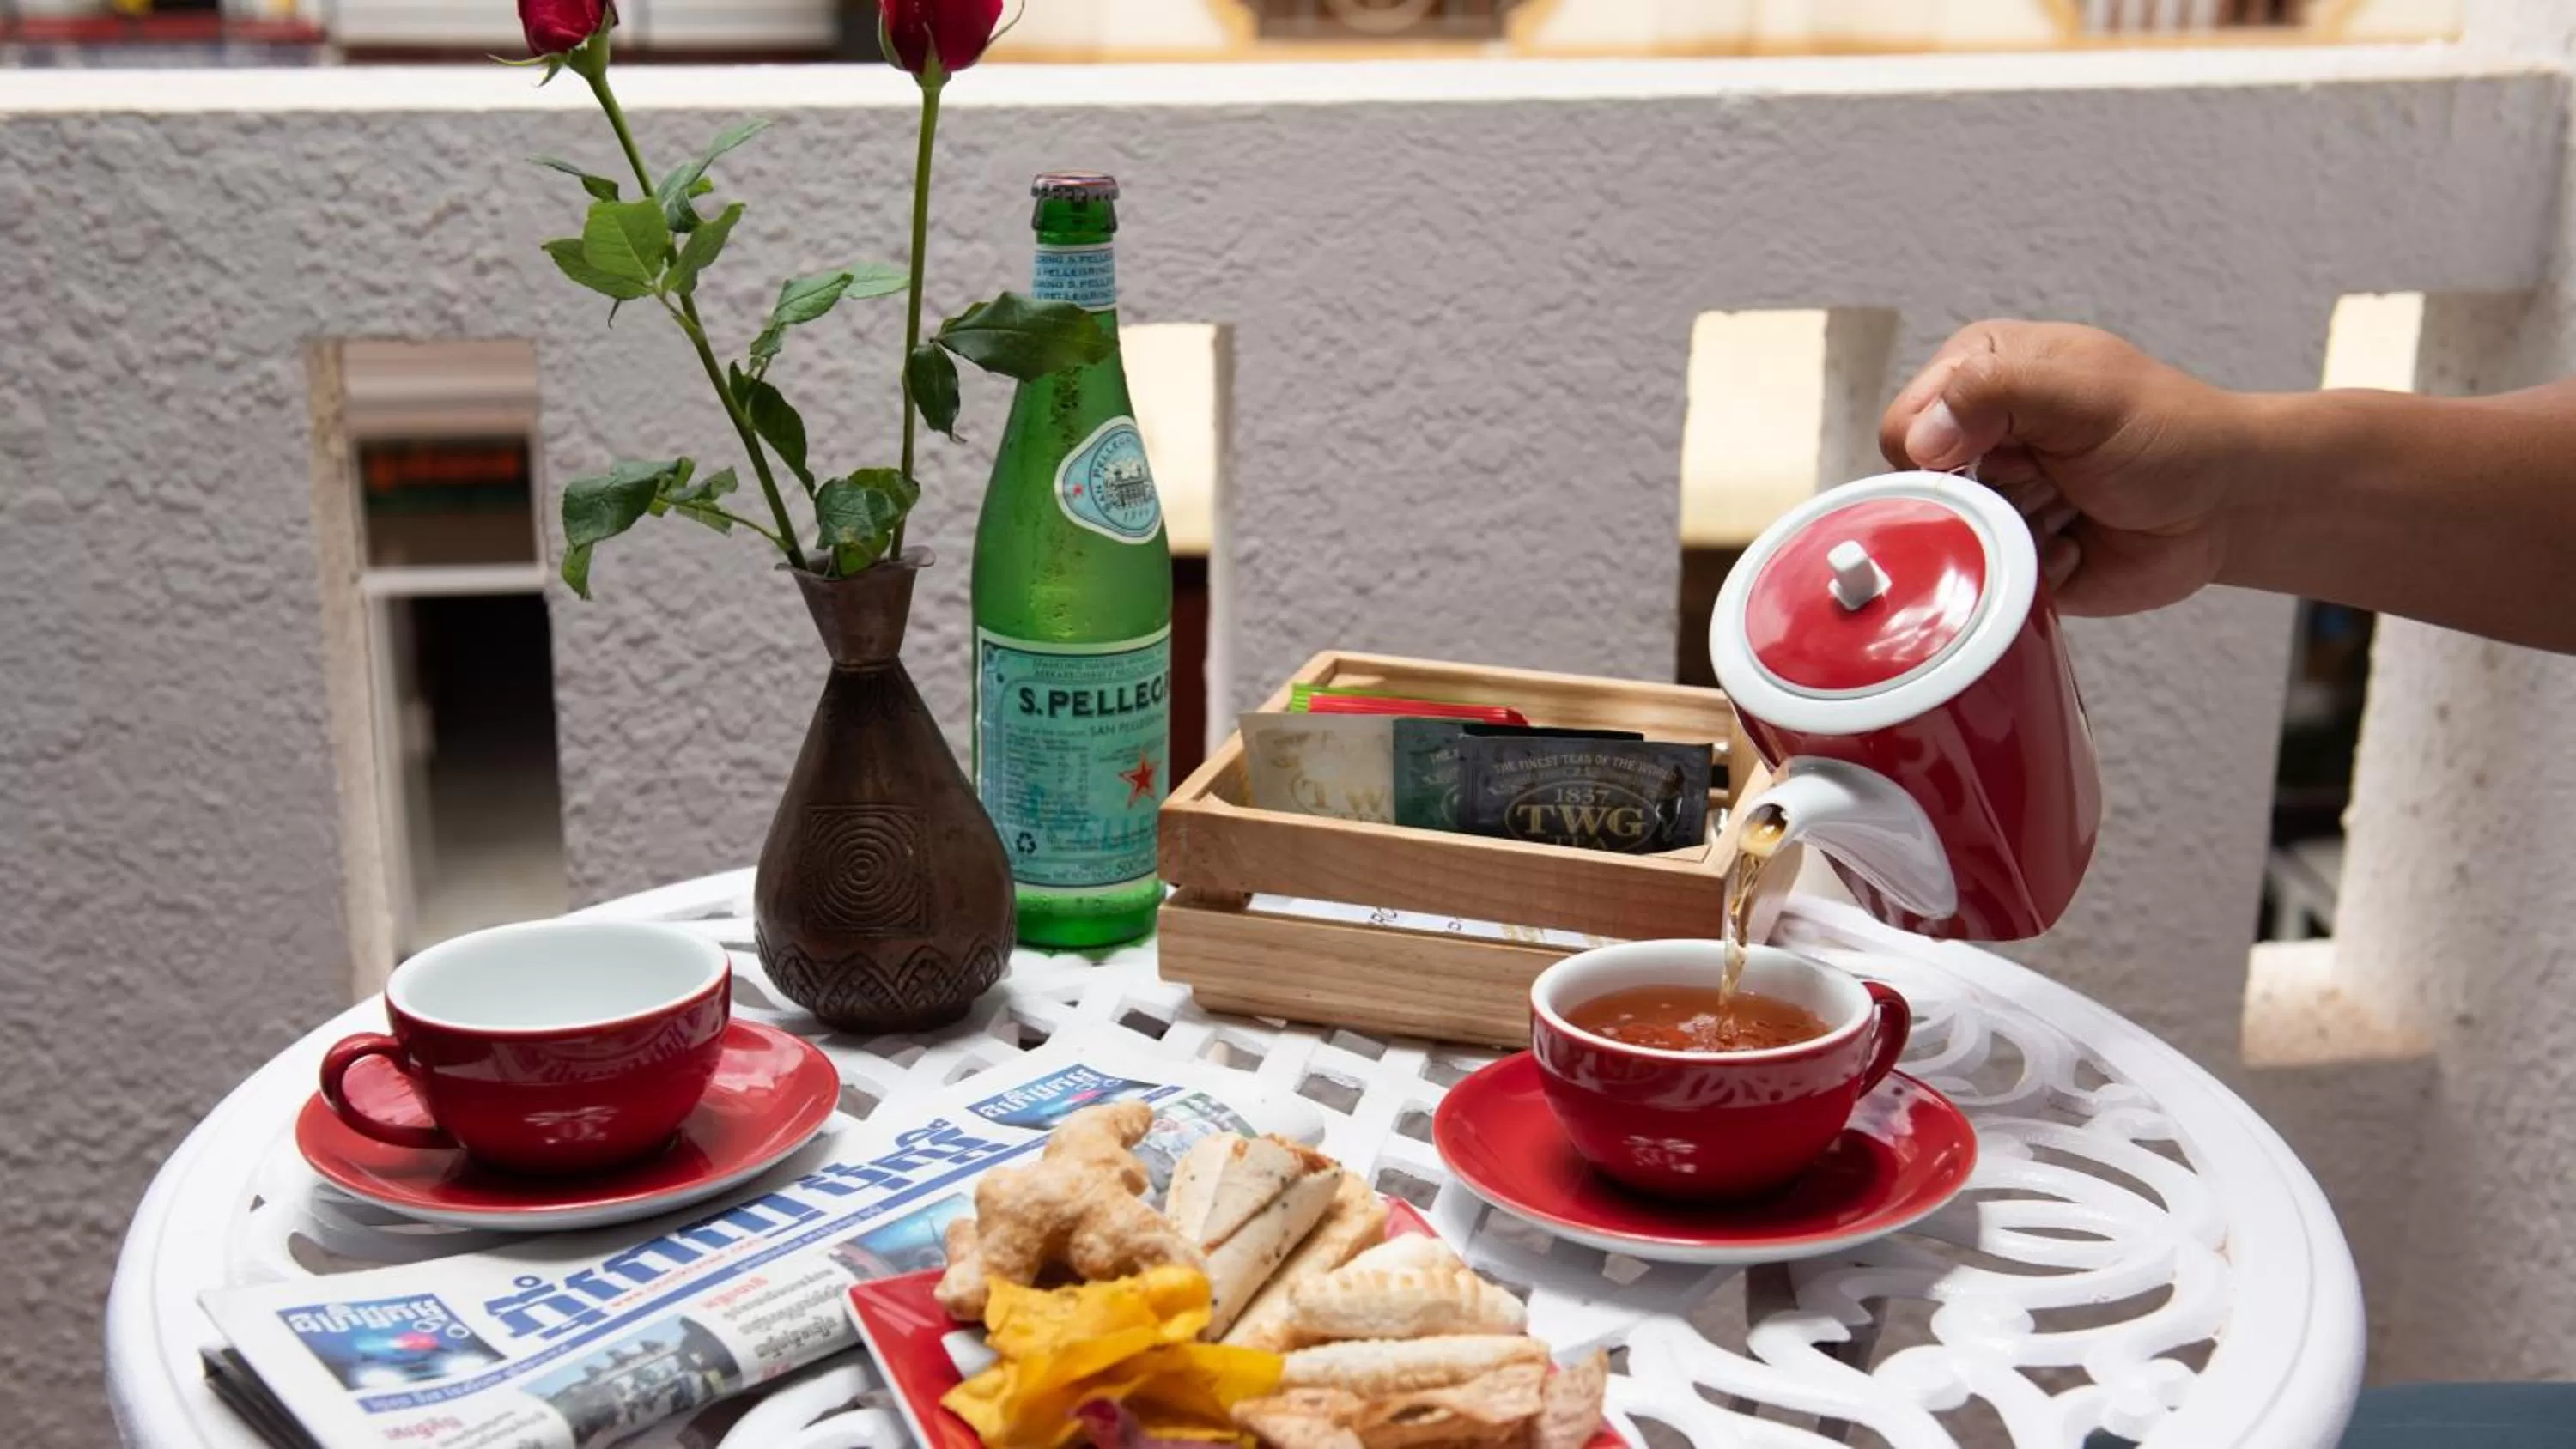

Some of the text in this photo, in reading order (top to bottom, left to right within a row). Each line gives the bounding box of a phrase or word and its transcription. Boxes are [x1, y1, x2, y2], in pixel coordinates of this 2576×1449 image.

[1517, 755, 1558, 771] FINEST
[1562, 754, 1590, 767] TEAS
[1595, 754, 1610, 767] OF
[1612, 755, 1637, 771] THE
[1554, 787, 1611, 803] 1837
[1516, 803, 1647, 838] TWG
